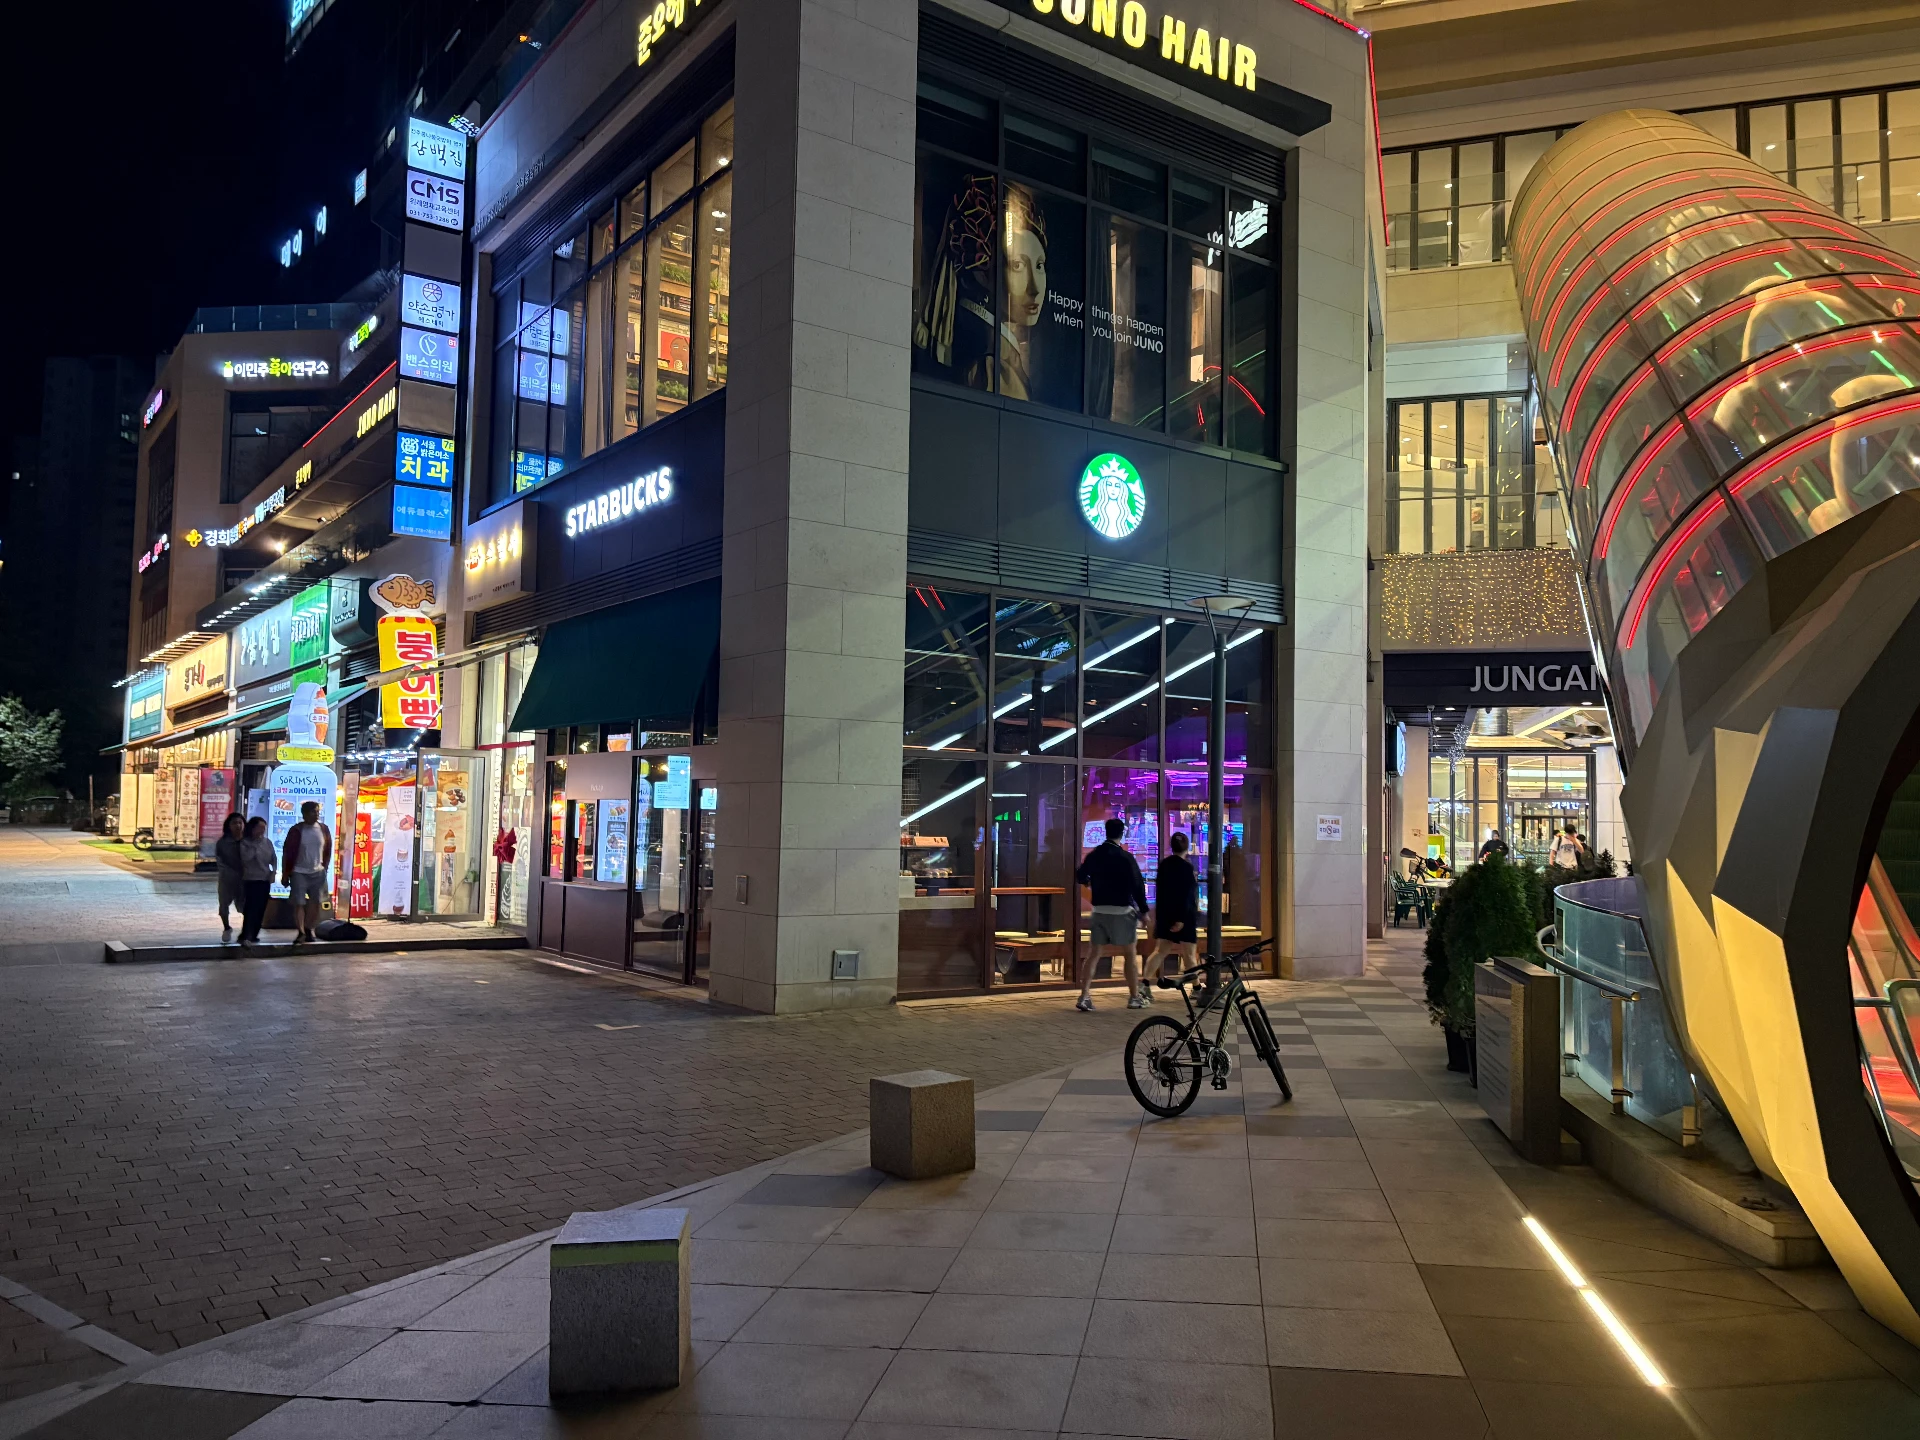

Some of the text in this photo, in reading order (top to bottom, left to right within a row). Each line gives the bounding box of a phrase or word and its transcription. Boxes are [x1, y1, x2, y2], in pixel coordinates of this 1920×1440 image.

[638, 0, 701, 67] 준오헤
[1161, 14, 1257, 92] HAIR
[411, 139, 463, 168] 삼백집
[410, 178, 460, 205] CMS
[407, 299, 455, 322] 약손명가
[1048, 289, 1164, 337] Happy things happen
[1053, 312, 1164, 354] when you join JUNO
[233, 357, 329, 378] 이민주육아연구소
[405, 353, 453, 374] 밴스의원
[420, 448, 449, 460] 밝은미소
[421, 439, 435, 449] 서울
[400, 455, 449, 484] 치과
[565, 466, 672, 538] STARBUCKS
[396, 630, 438, 729] 붕어빵
